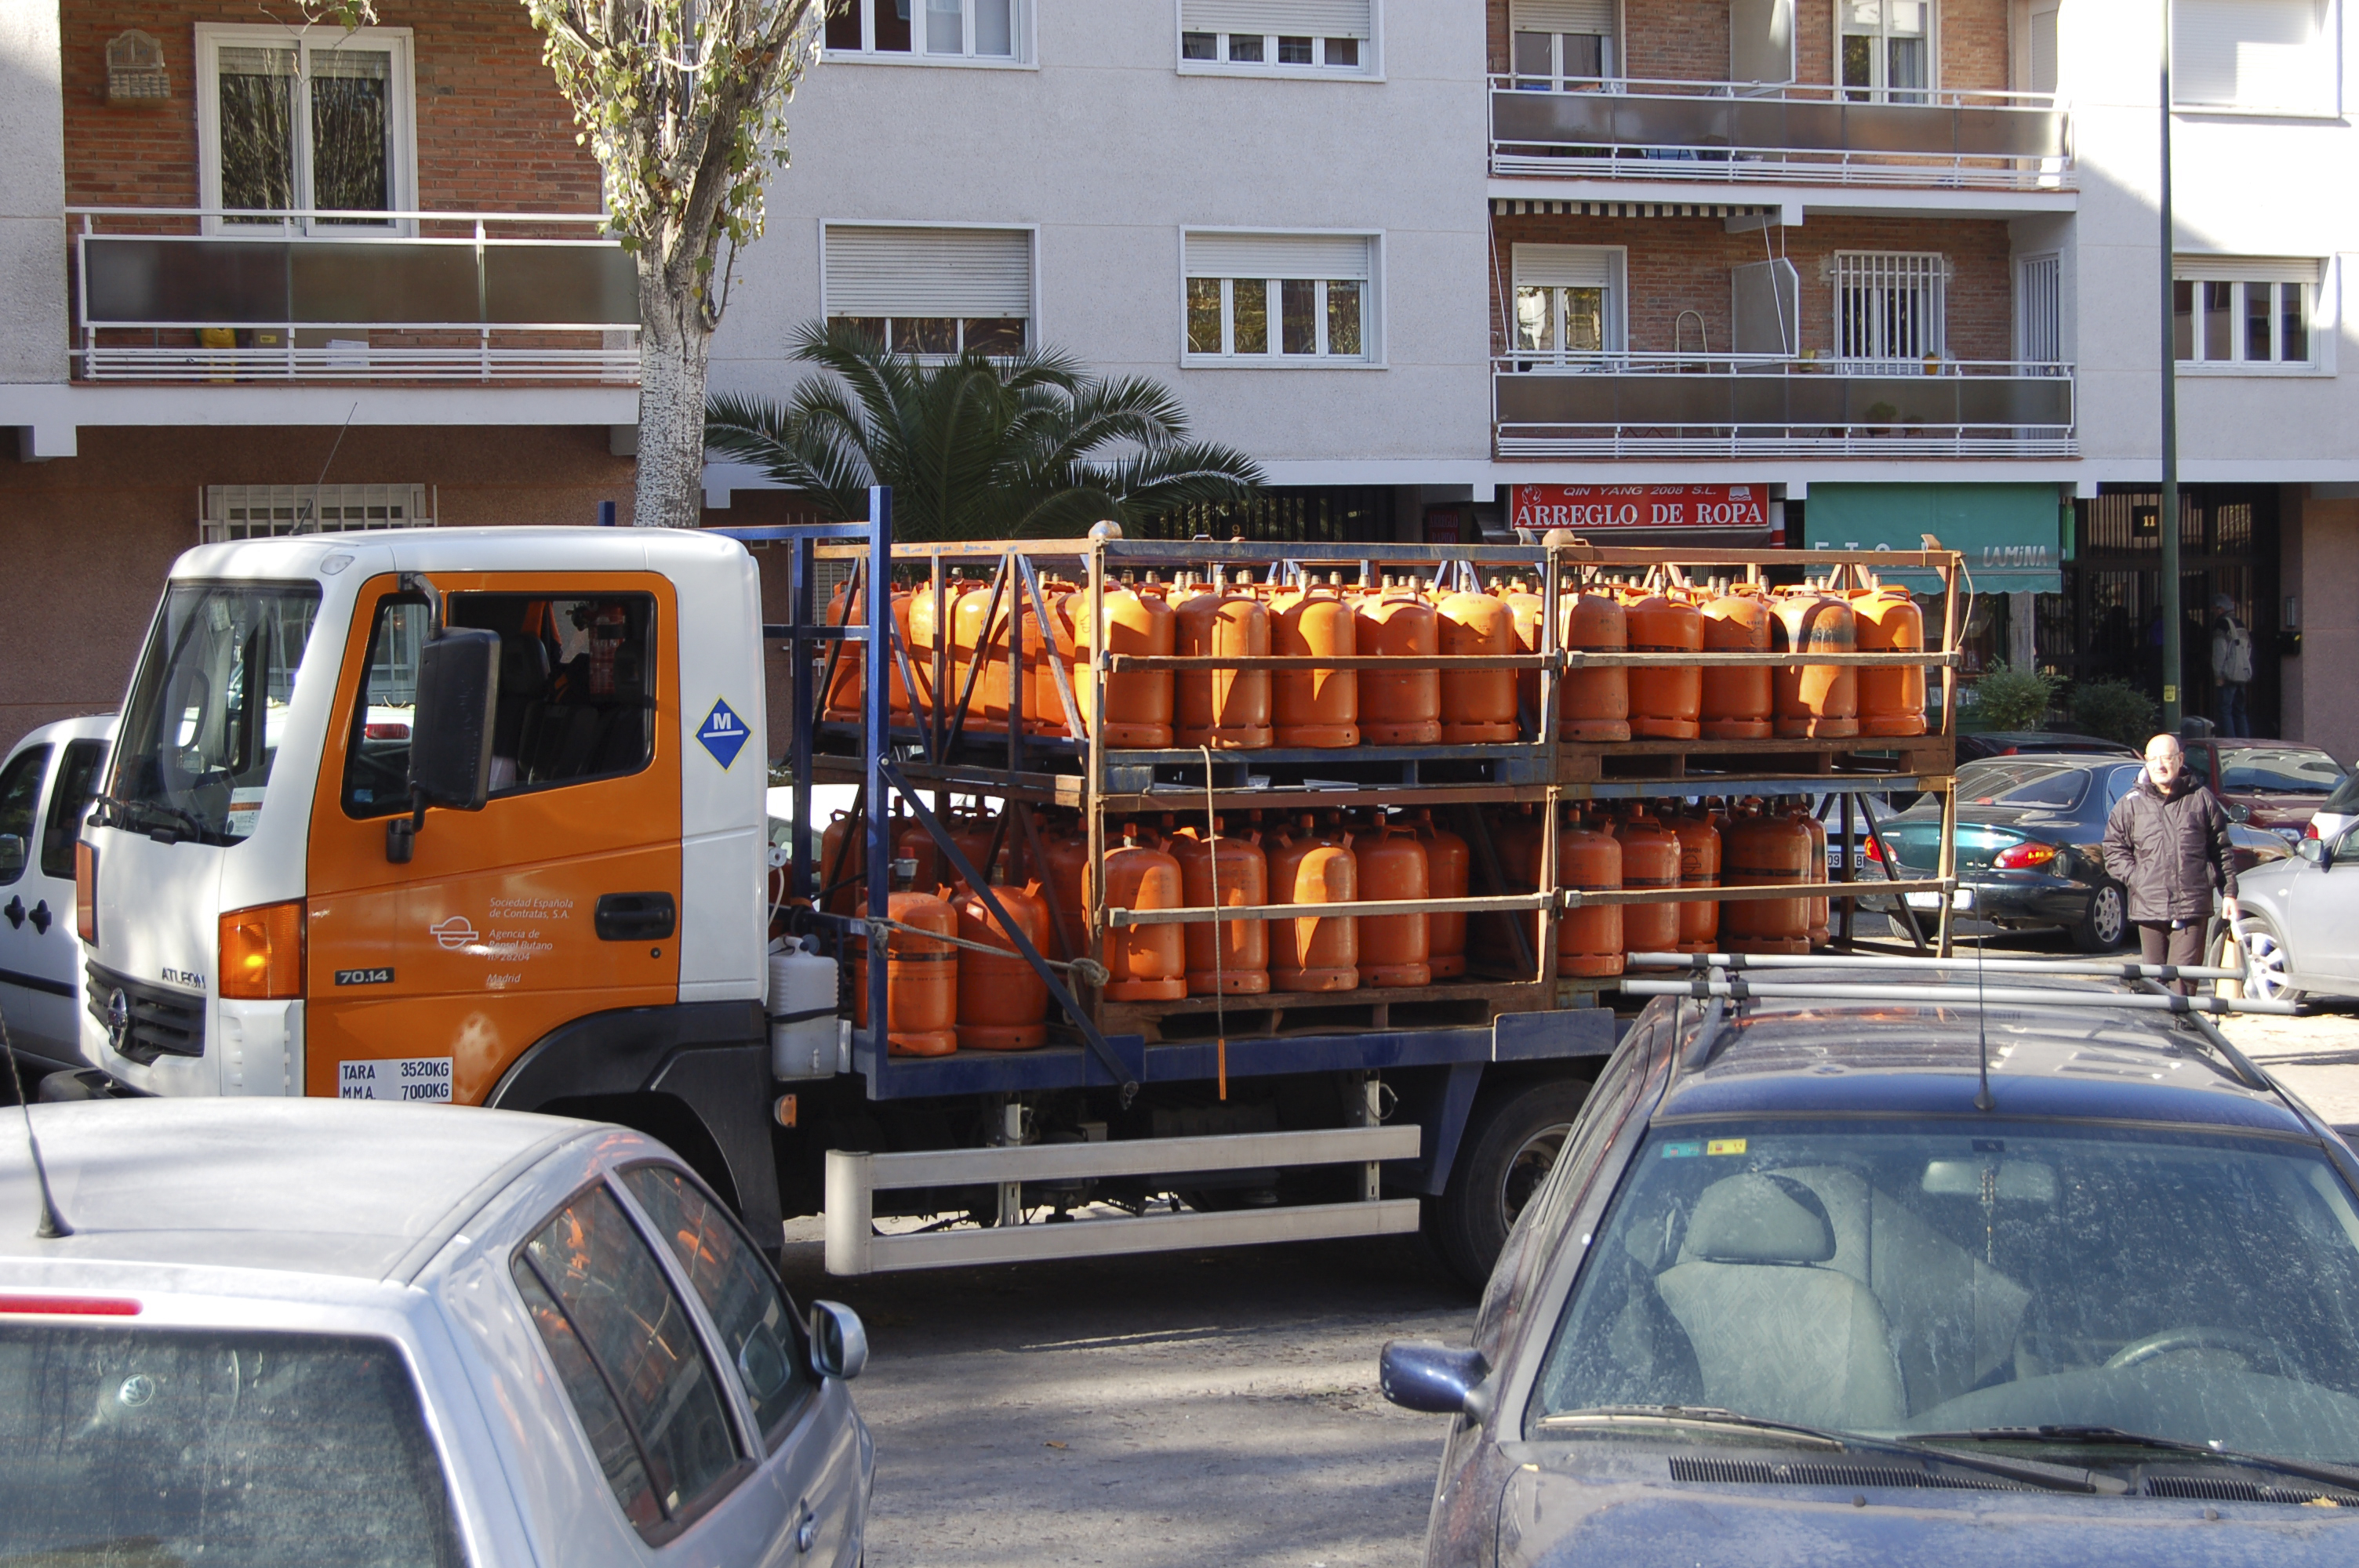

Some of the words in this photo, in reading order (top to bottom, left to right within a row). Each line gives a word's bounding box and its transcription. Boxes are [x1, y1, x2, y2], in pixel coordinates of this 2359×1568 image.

[1563, 487, 1590, 496] QIN
[1600, 486, 1643, 495] YANG
[1650, 486, 1684, 495] 2008
[1691, 486, 1717, 495] S.L.
[1514, 503, 1638, 526] ARREGLO
[1651, 503, 1683, 524] DE
[1696, 503, 1763, 524] ROPA
[2143, 514, 2156, 528] 11
[713, 713, 732, 730] M
[490, 897, 531, 908] Sociedad
[533, 898, 573, 909] Española
[489, 908, 500, 918] de
[503, 909, 549, 920] Contratas,
[552, 909, 569, 919] S.A.
[489, 928, 525, 940] Agencia
[528, 929, 540, 938] de
[489, 940, 519, 950] Repsol
[521, 941, 553, 950] Butano
[500, 952, 530, 961] 28204
[162, 967, 206, 989] ATLEON
[340, 970, 388, 984] 70.14
[487, 973, 522, 983] Madrid
[343, 1065, 376, 1080] TARA
[401, 1061, 449, 1077] 3520KG
[401, 1083, 449, 1101] 7000KG
